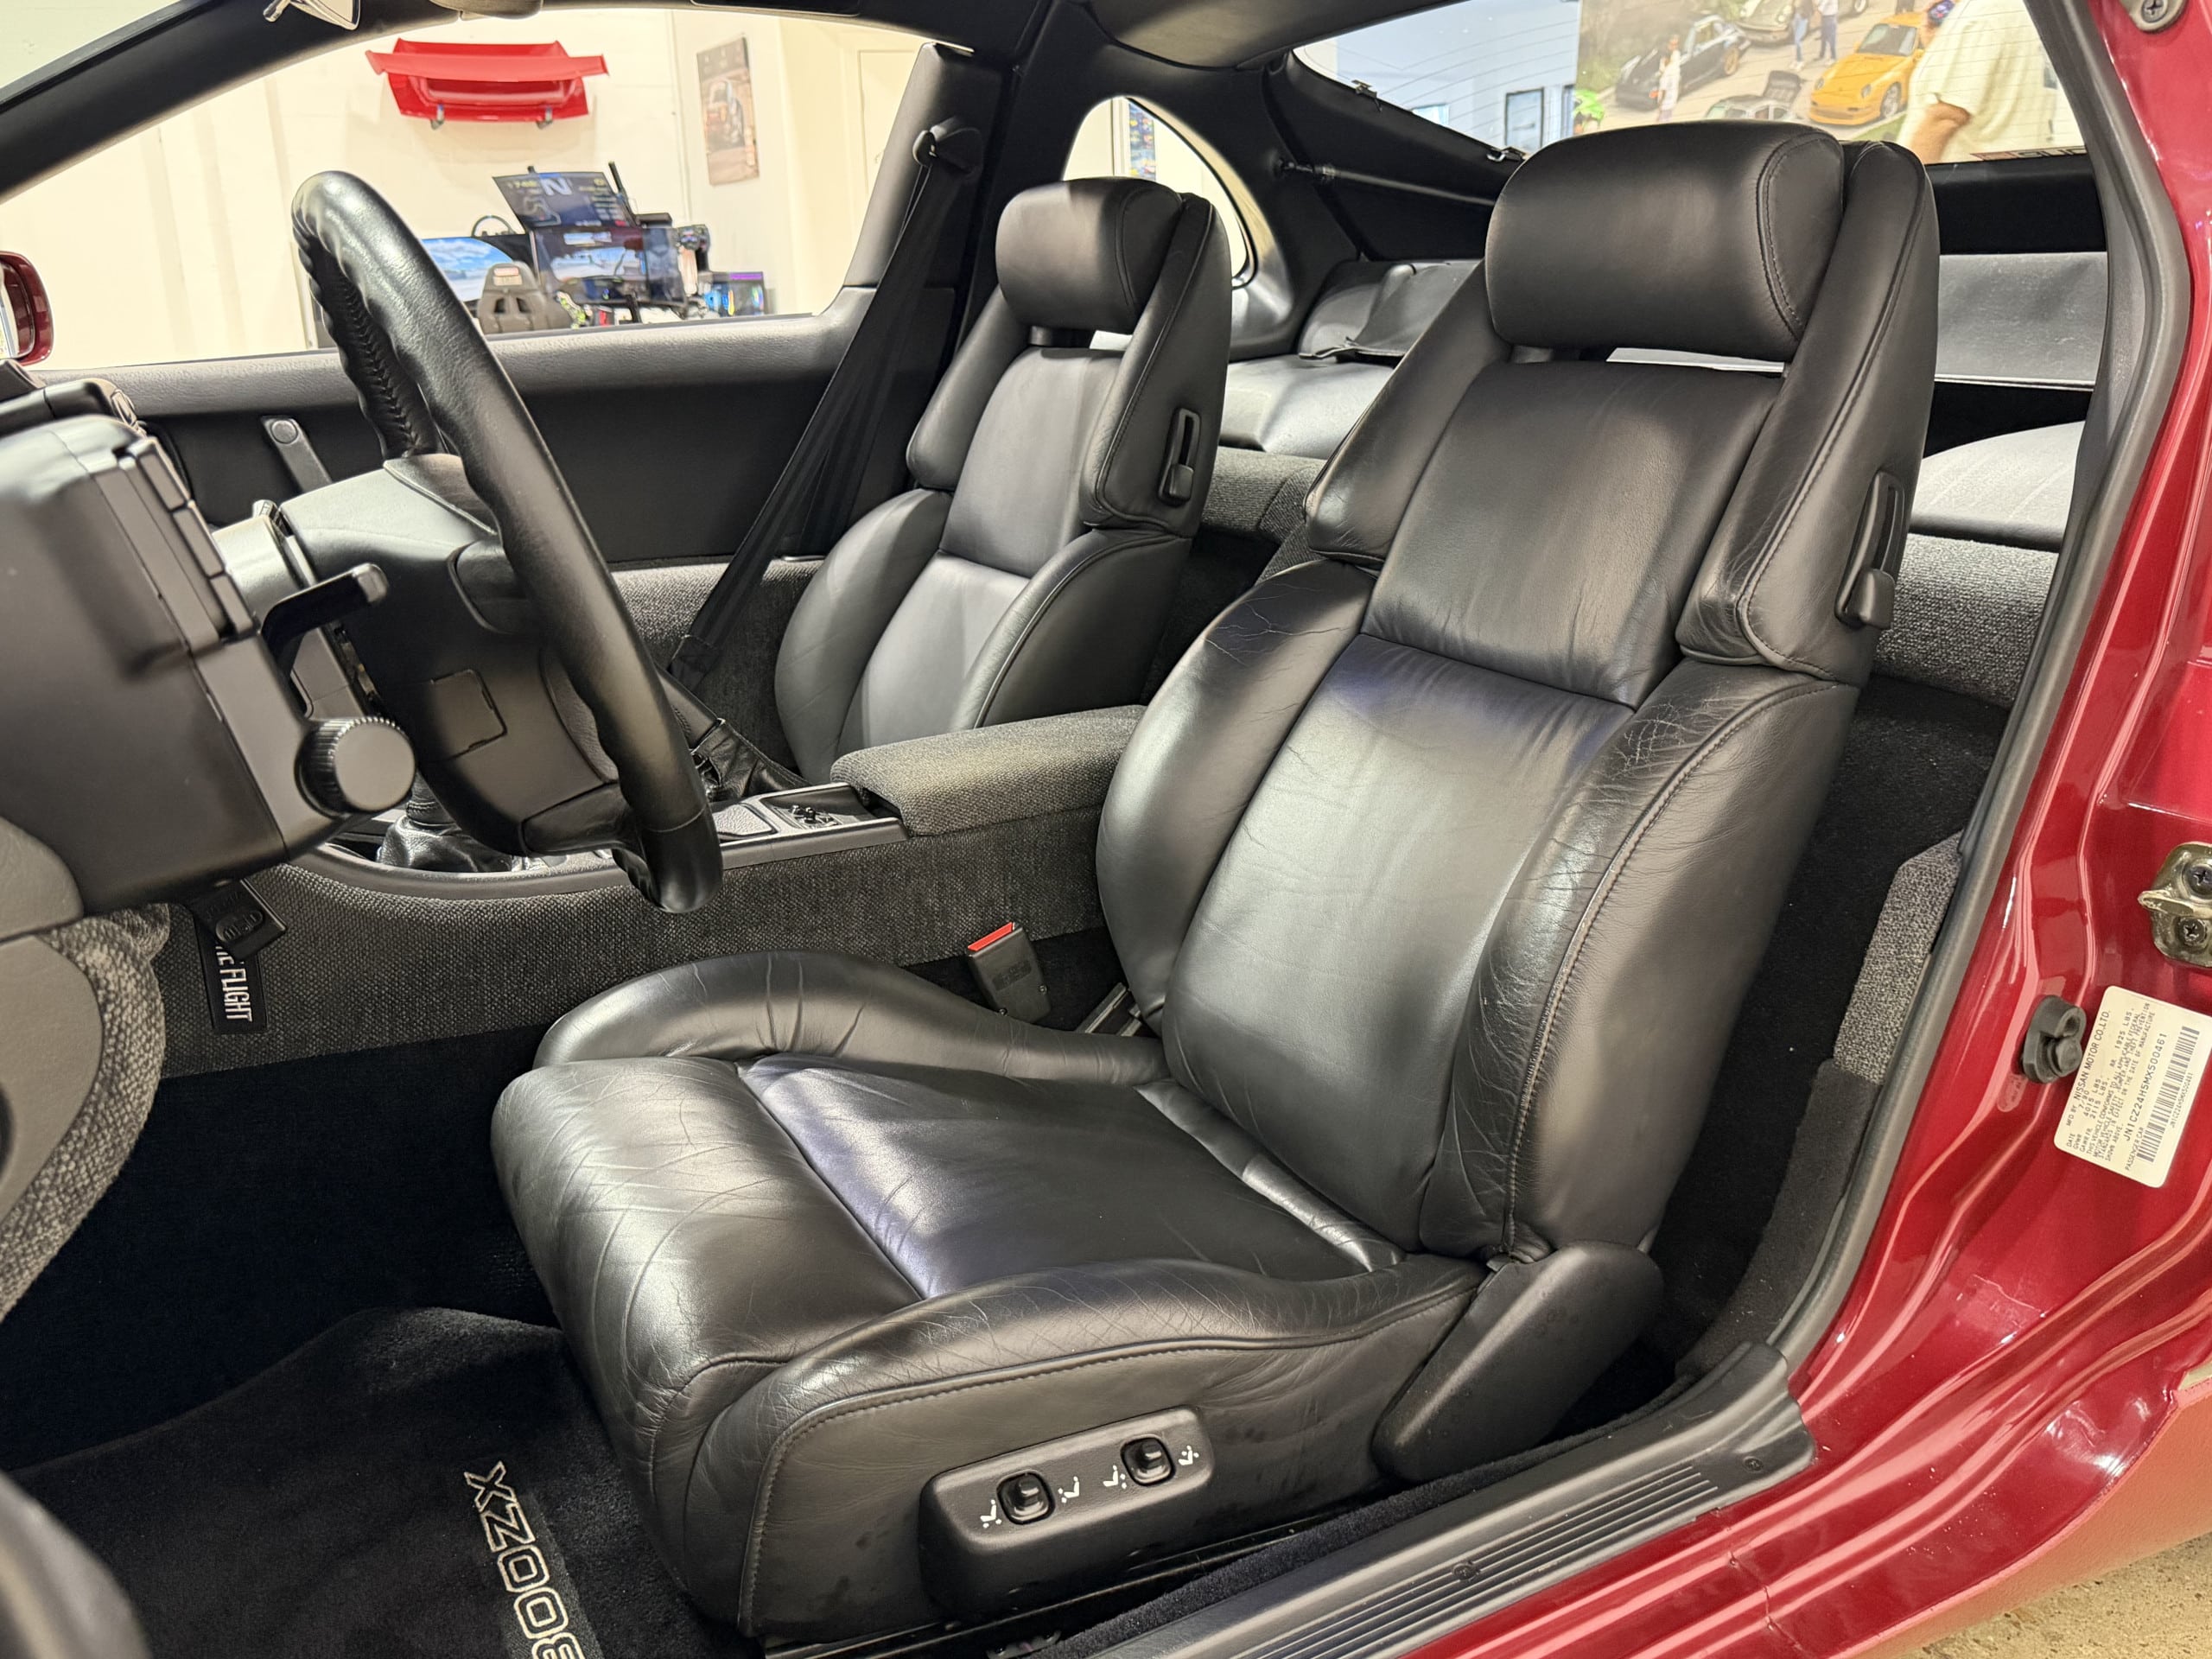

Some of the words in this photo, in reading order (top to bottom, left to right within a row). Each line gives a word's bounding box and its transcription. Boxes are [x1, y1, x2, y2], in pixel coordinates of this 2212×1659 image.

[219, 968, 253, 1022] FLIGHT
[2138, 1012, 2155, 1048] MANUFACTURE
[2073, 1071, 2089, 1101] NISSAN
[2083, 1042, 2100, 1071] MOTOR
[2086, 1141, 2095, 1154] THIS
[2091, 1119, 2103, 1141] VEHICLE
[2099, 1090, 2114, 1119] CONFORMS
[2127, 1014, 2141, 1037] FEDERAL
[2089, 1100, 2101, 1119] 2115
[2098, 1077, 2110, 1096] LBS.
[2114, 1030, 2126, 1049] 1925
[2123, 1033, 2167, 1141] JN1CZ24H5MX500461
[2124, 1075, 2133, 1085] THE
[2128, 1059, 2139, 1074] DATE
[2066, 1133, 2075, 1147] DATE
[2078, 1090, 2089, 1109] 7/90
[2082, 1097, 2094, 1116] 4015
[2092, 1138, 2103, 1158] MOTOR
[2099, 1116, 2112, 1138] VEHICLE
[2107, 1095, 2119, 1116] SAFETY
[2112, 1097, 2125, 1118] EFFECT
[2097, 1129, 2113, 1159] STANDARDS
[2124, 1139, 2140, 1172] PASSENGER
[2136, 1127, 2145, 1139] CAR
